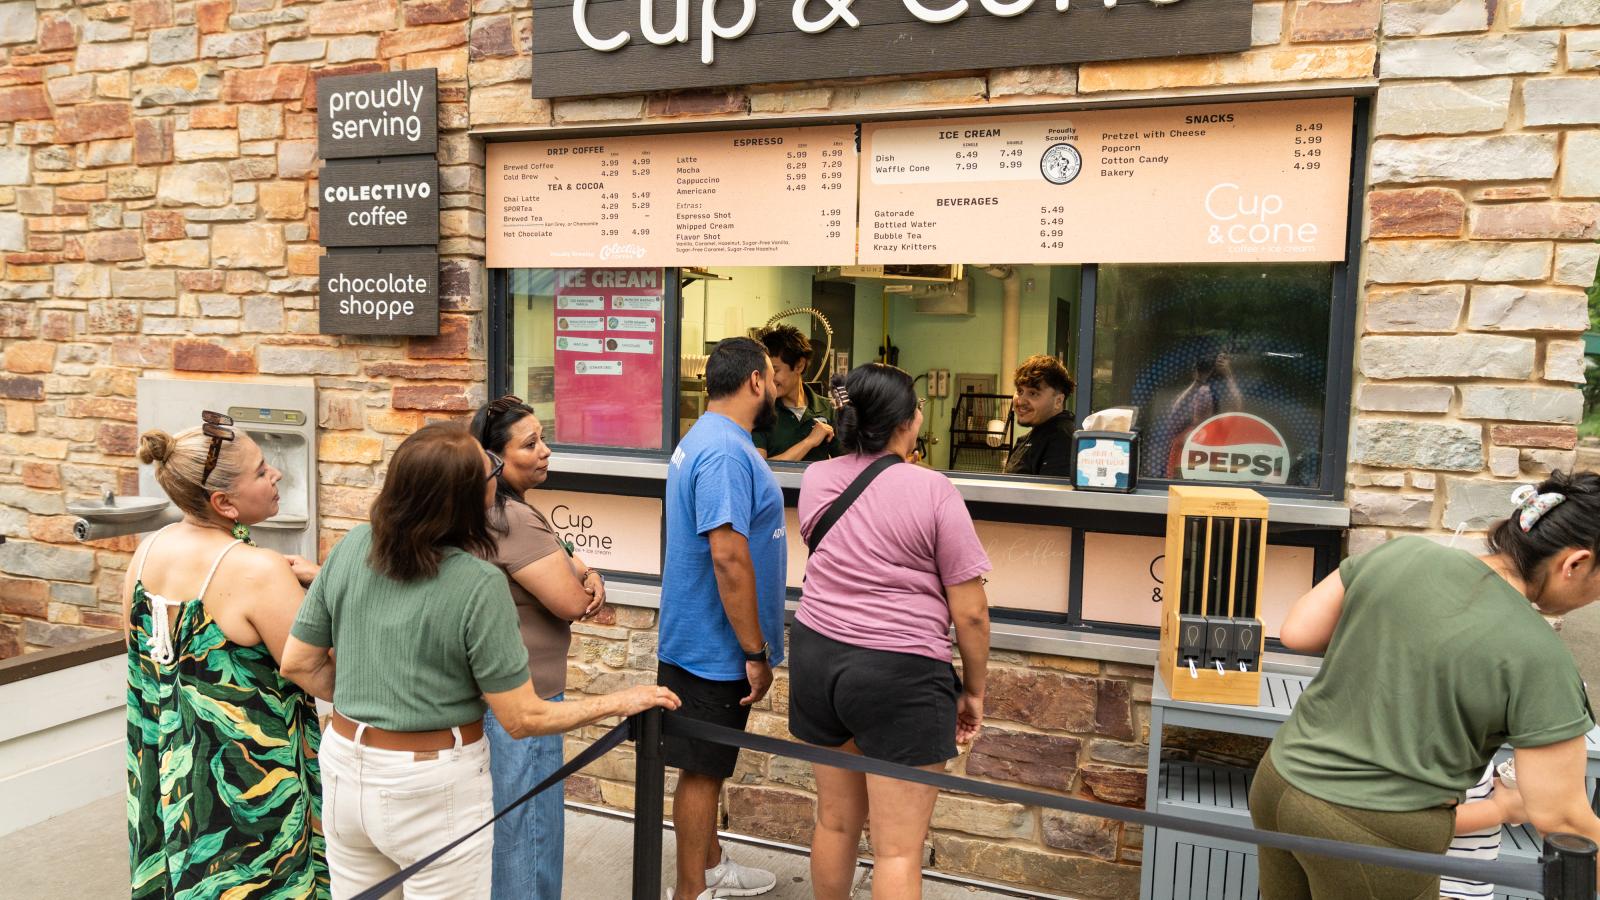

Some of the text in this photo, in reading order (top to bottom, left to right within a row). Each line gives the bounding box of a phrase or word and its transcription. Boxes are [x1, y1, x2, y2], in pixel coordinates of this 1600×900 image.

[329, 80, 423, 118] proudly
[1185, 114, 1235, 124] SNACKS
[332, 112, 421, 141] serving
[1048, 127, 1077, 135] Proudly
[1102, 123, 1323, 141] Pretzel with Cheese 8.49
[938, 129, 1001, 140] ICE CREAM
[733, 137, 784, 147] ESPRESSO
[1101, 136, 1322, 154] Popcorn 5.99
[547, 146, 605, 156] DRIP COFFEE
[876, 149, 1023, 163] Dish 6.49 7.49
[1101, 149, 1322, 165] Cotton Candy 5.49
[632, 158, 651, 166] 4.99
[676, 156, 697, 164] Latte
[786, 151, 807, 159] 5.99
[786, 162, 807, 170] 6.29
[876, 161, 1023, 173] Waffle Cone 7.99 9.99
[1100, 162, 1321, 178] Bakery 4.99
[676, 177, 720, 185] Cappuccino
[786, 173, 807, 181] 5.99
[324, 182, 431, 203] COLECTIVO
[566, 183, 573, 191] &
[576, 182, 604, 190] COCOA
[786, 184, 806, 192] 4.49
[936, 197, 999, 207] BEVERAGES
[1205, 182, 1283, 222] Cup
[503, 205, 533, 213] SPORTea
[874, 206, 1064, 218] Gatorade 5.49
[348, 206, 408, 226] coffee
[676, 212, 711, 221] Espresso
[676, 223, 707, 232] Whipped
[709, 222, 735, 230] Cream
[874, 217, 1064, 229] Bottled Water 5.49
[518, 230, 553, 238] Chocolate
[874, 232, 903, 240] Bubble
[1040, 229, 1064, 237] 6.99
[873, 241, 1064, 252] Krazy Kritters 4.49
[328, 273, 427, 294] chocolate
[559, 270, 657, 288] ICE CREAM
[339, 295, 415, 320] shoppe
[1188, 449, 1284, 477] PEPSI
[551, 504, 593, 533] Cup
